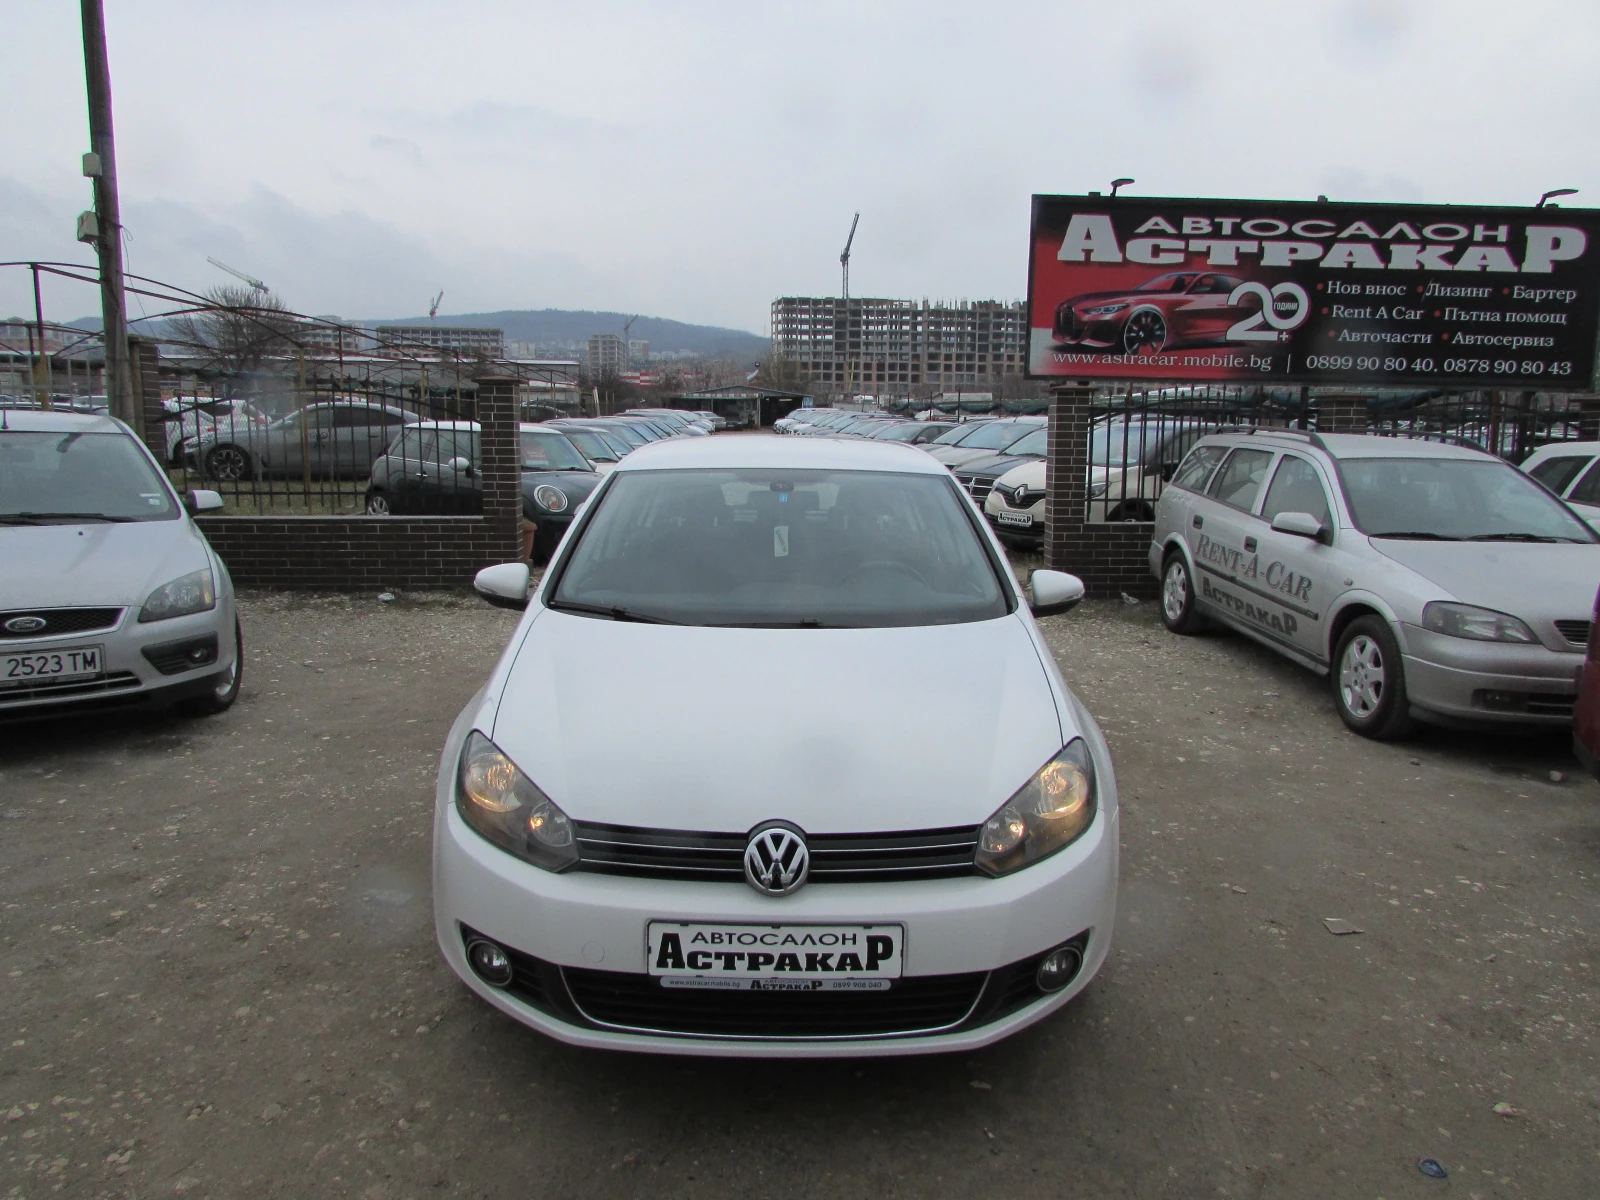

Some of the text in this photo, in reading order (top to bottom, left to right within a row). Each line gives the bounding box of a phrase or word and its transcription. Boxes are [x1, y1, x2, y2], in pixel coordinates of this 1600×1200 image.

[1326, 281, 1407, 296] Нов внос
[1425, 283, 1492, 298] Лизинг
[1512, 285, 1577, 303] Бартер
[1274, 302, 1298, 311] ГОДИНИ
[1332, 305, 1424, 320] Rent A Car
[1443, 308, 1568, 326] Пътна помощ
[1337, 329, 1432, 344] Авточасти
[1451, 332, 1555, 350] Автосервиз
[1052, 353, 1272, 372] www.astracar.mobile.bg
[1306, 355, 1352, 369] 0899
[1356, 356, 1379, 370] 90
[1383, 357, 1407, 370] 80
[1443, 358, 1490, 373] 0878
[1493, 360, 1518, 373] 90
[1520, 360, 1546, 374] 80
[1547, 361, 1572, 375] 43
[1195, 534, 1313, 602] RENT-A-CAR
[7, 655, 63, 678] 2523
[691, 931, 857, 946] АВТОСАЛОН
[656, 932, 894, 972] АСТРАКАР
[750, 979, 823, 990] АСТРАКАР
